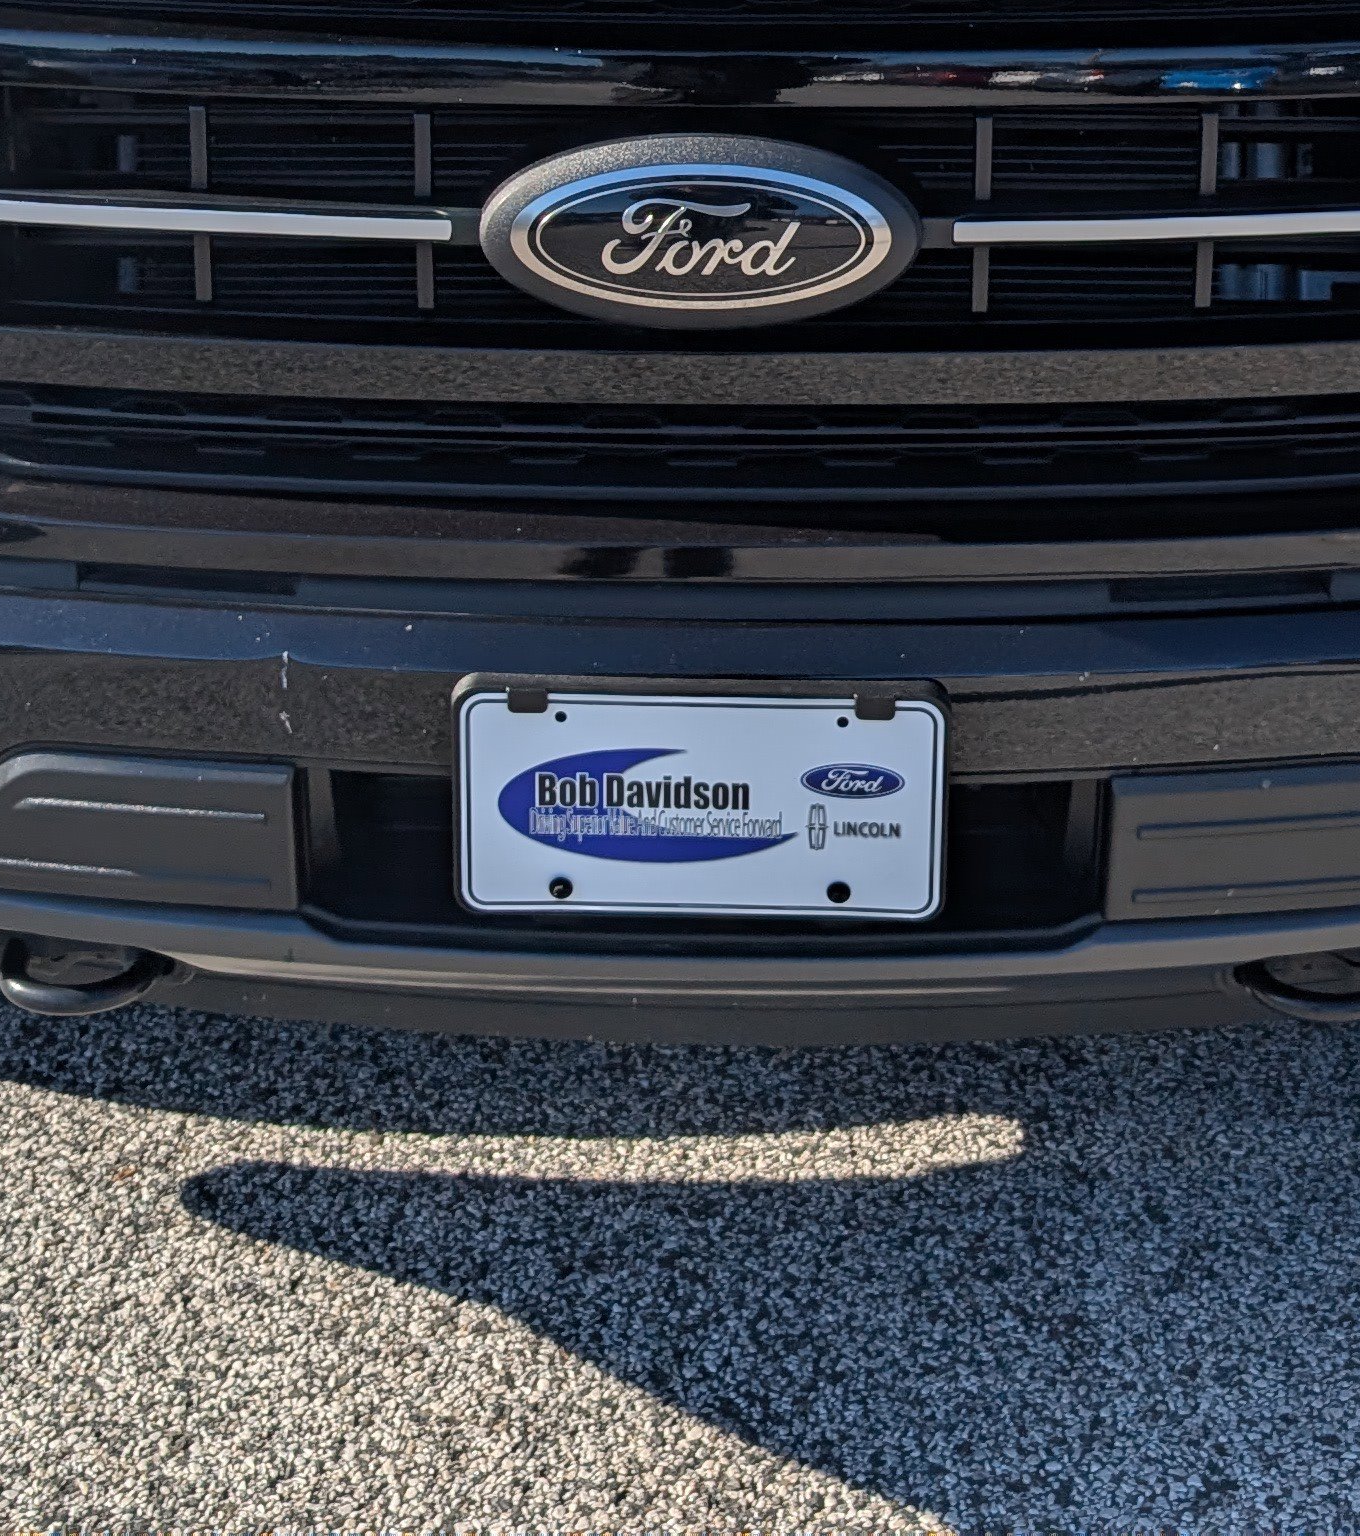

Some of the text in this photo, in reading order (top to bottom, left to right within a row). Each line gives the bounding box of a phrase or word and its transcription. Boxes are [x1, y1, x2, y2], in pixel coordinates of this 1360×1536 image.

[601, 198, 801, 276] Ford
[536, 772, 750, 810] Bob Davidson
[821, 768, 884, 792] Ford
[658, 809, 705, 837] Customer
[706, 810, 741, 837] Service
[742, 811, 782, 838] Forward
[833, 821, 901, 838] LINCOLN
